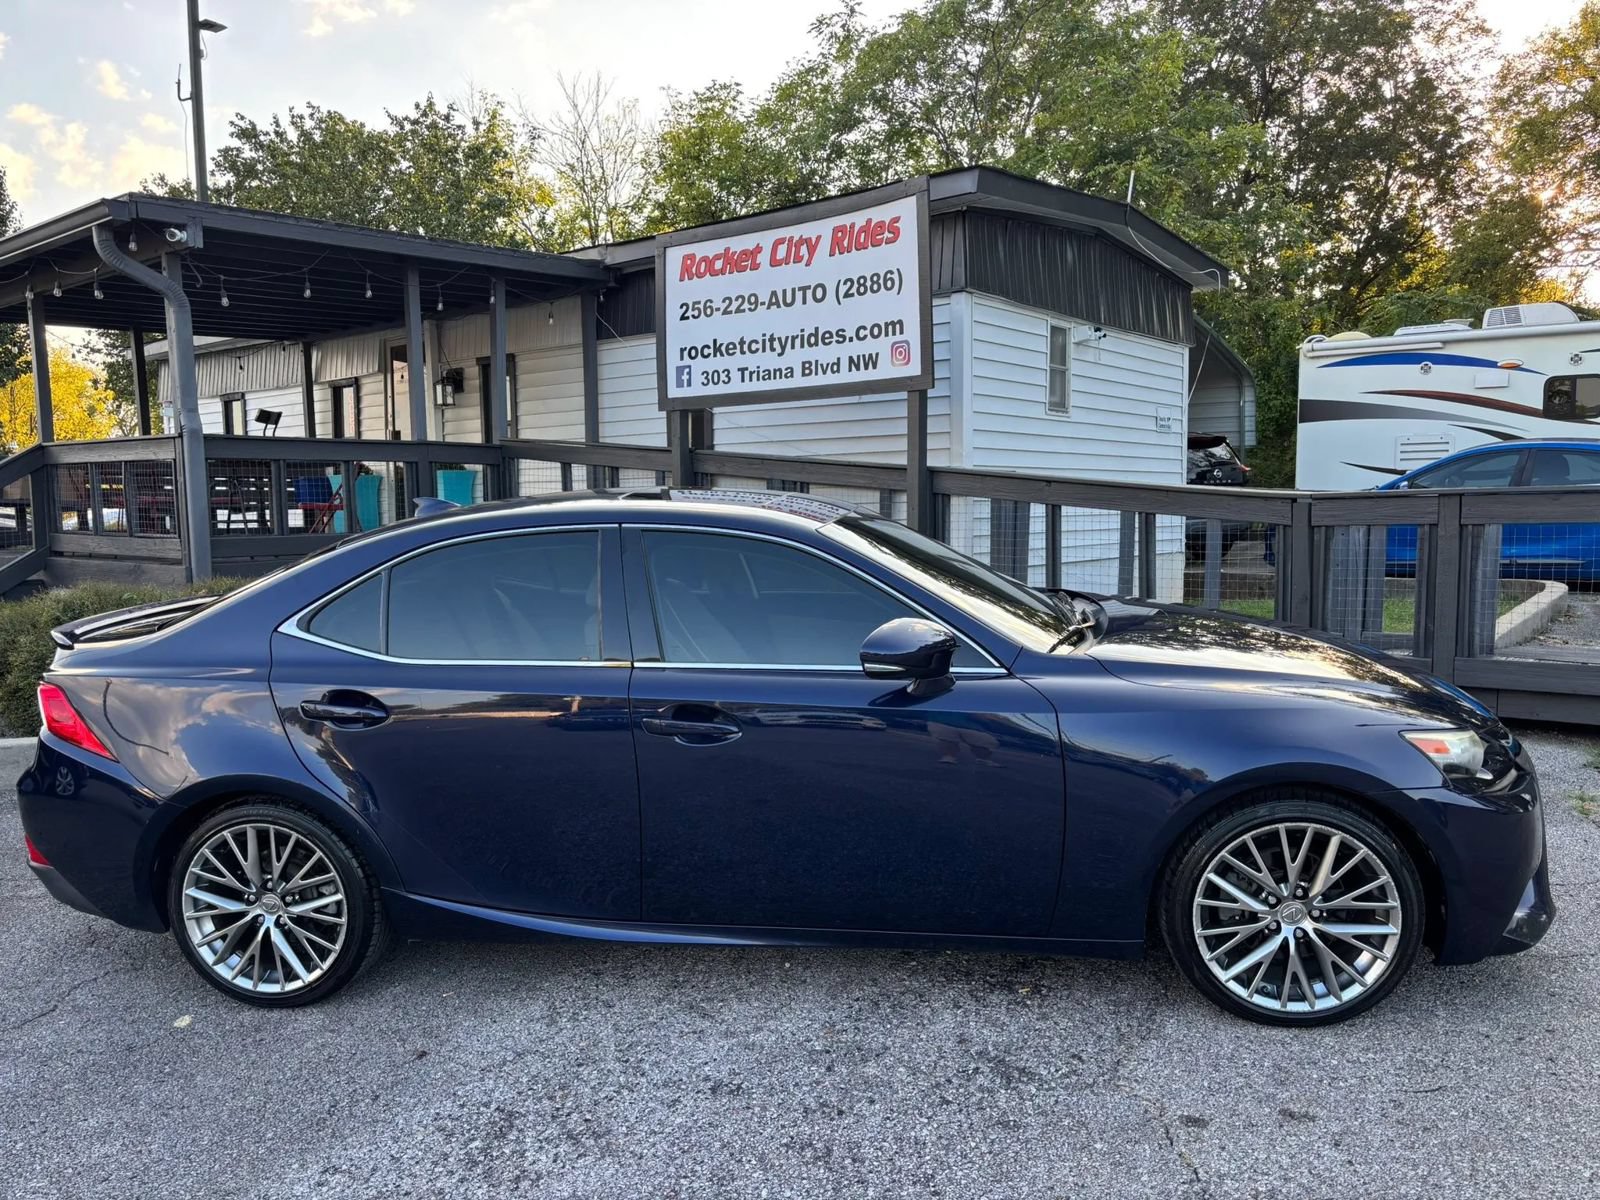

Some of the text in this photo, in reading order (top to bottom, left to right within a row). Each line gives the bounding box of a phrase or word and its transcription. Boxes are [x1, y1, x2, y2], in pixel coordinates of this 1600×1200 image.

[679, 215, 902, 282] Rocket City Rides
[679, 268, 903, 321] 256-229-AUTO (2886)
[679, 318, 904, 362] rocketcityrides.com
[700, 352, 880, 387] 303 Triana Blvd NW
